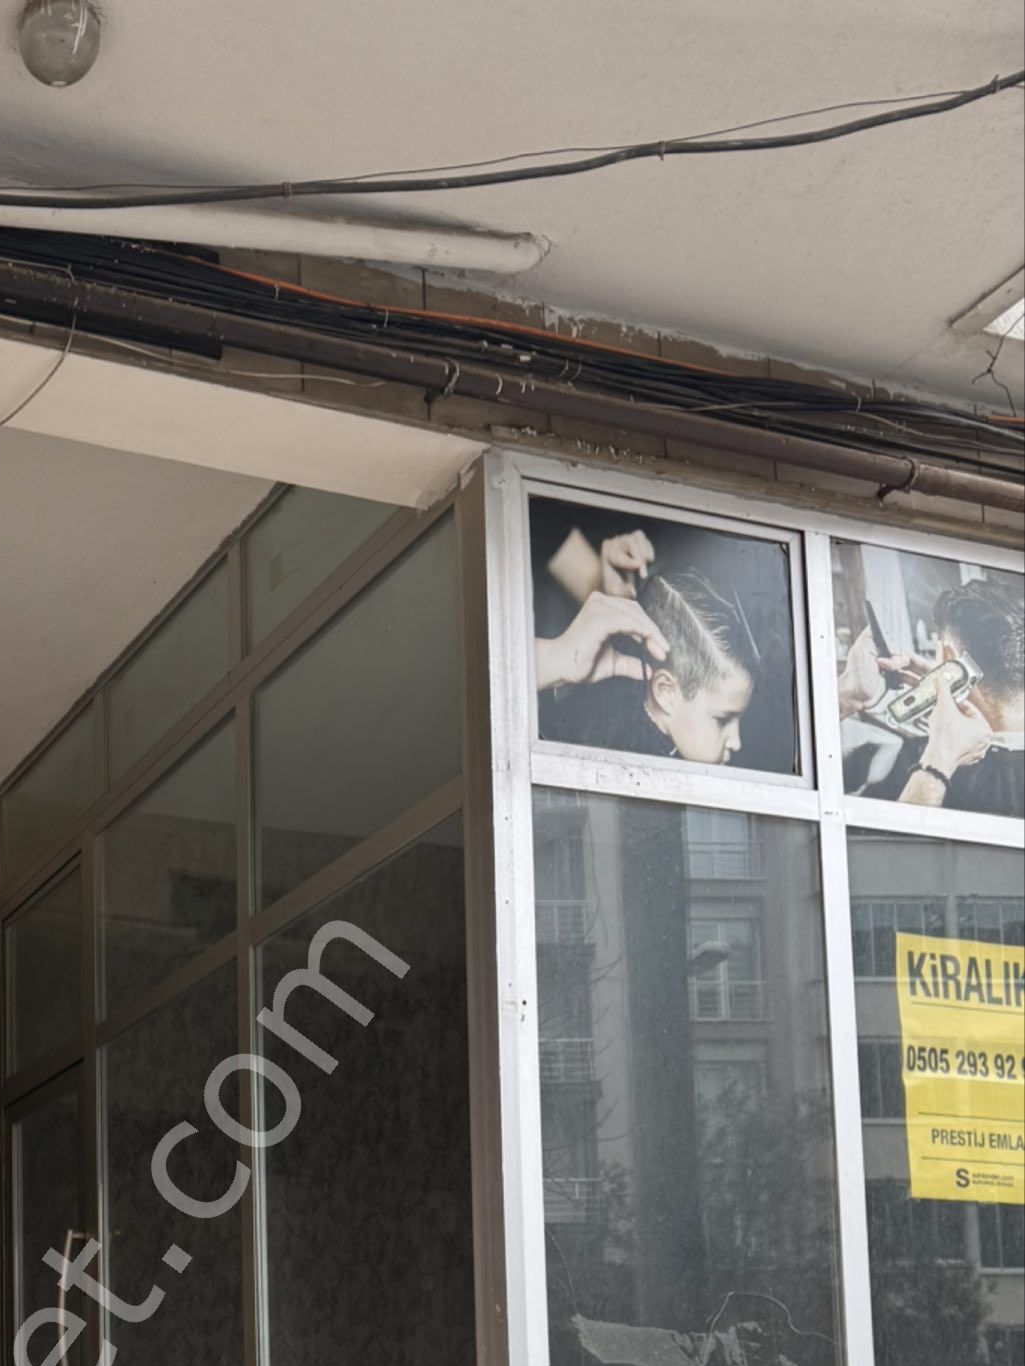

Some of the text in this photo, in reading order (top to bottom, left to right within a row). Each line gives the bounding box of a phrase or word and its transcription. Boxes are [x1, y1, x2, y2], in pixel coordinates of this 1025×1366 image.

[906, 1044, 950, 1074] 0505
[955, 1049, 990, 1077] 293
[994, 1053, 1017, 1080] 92
